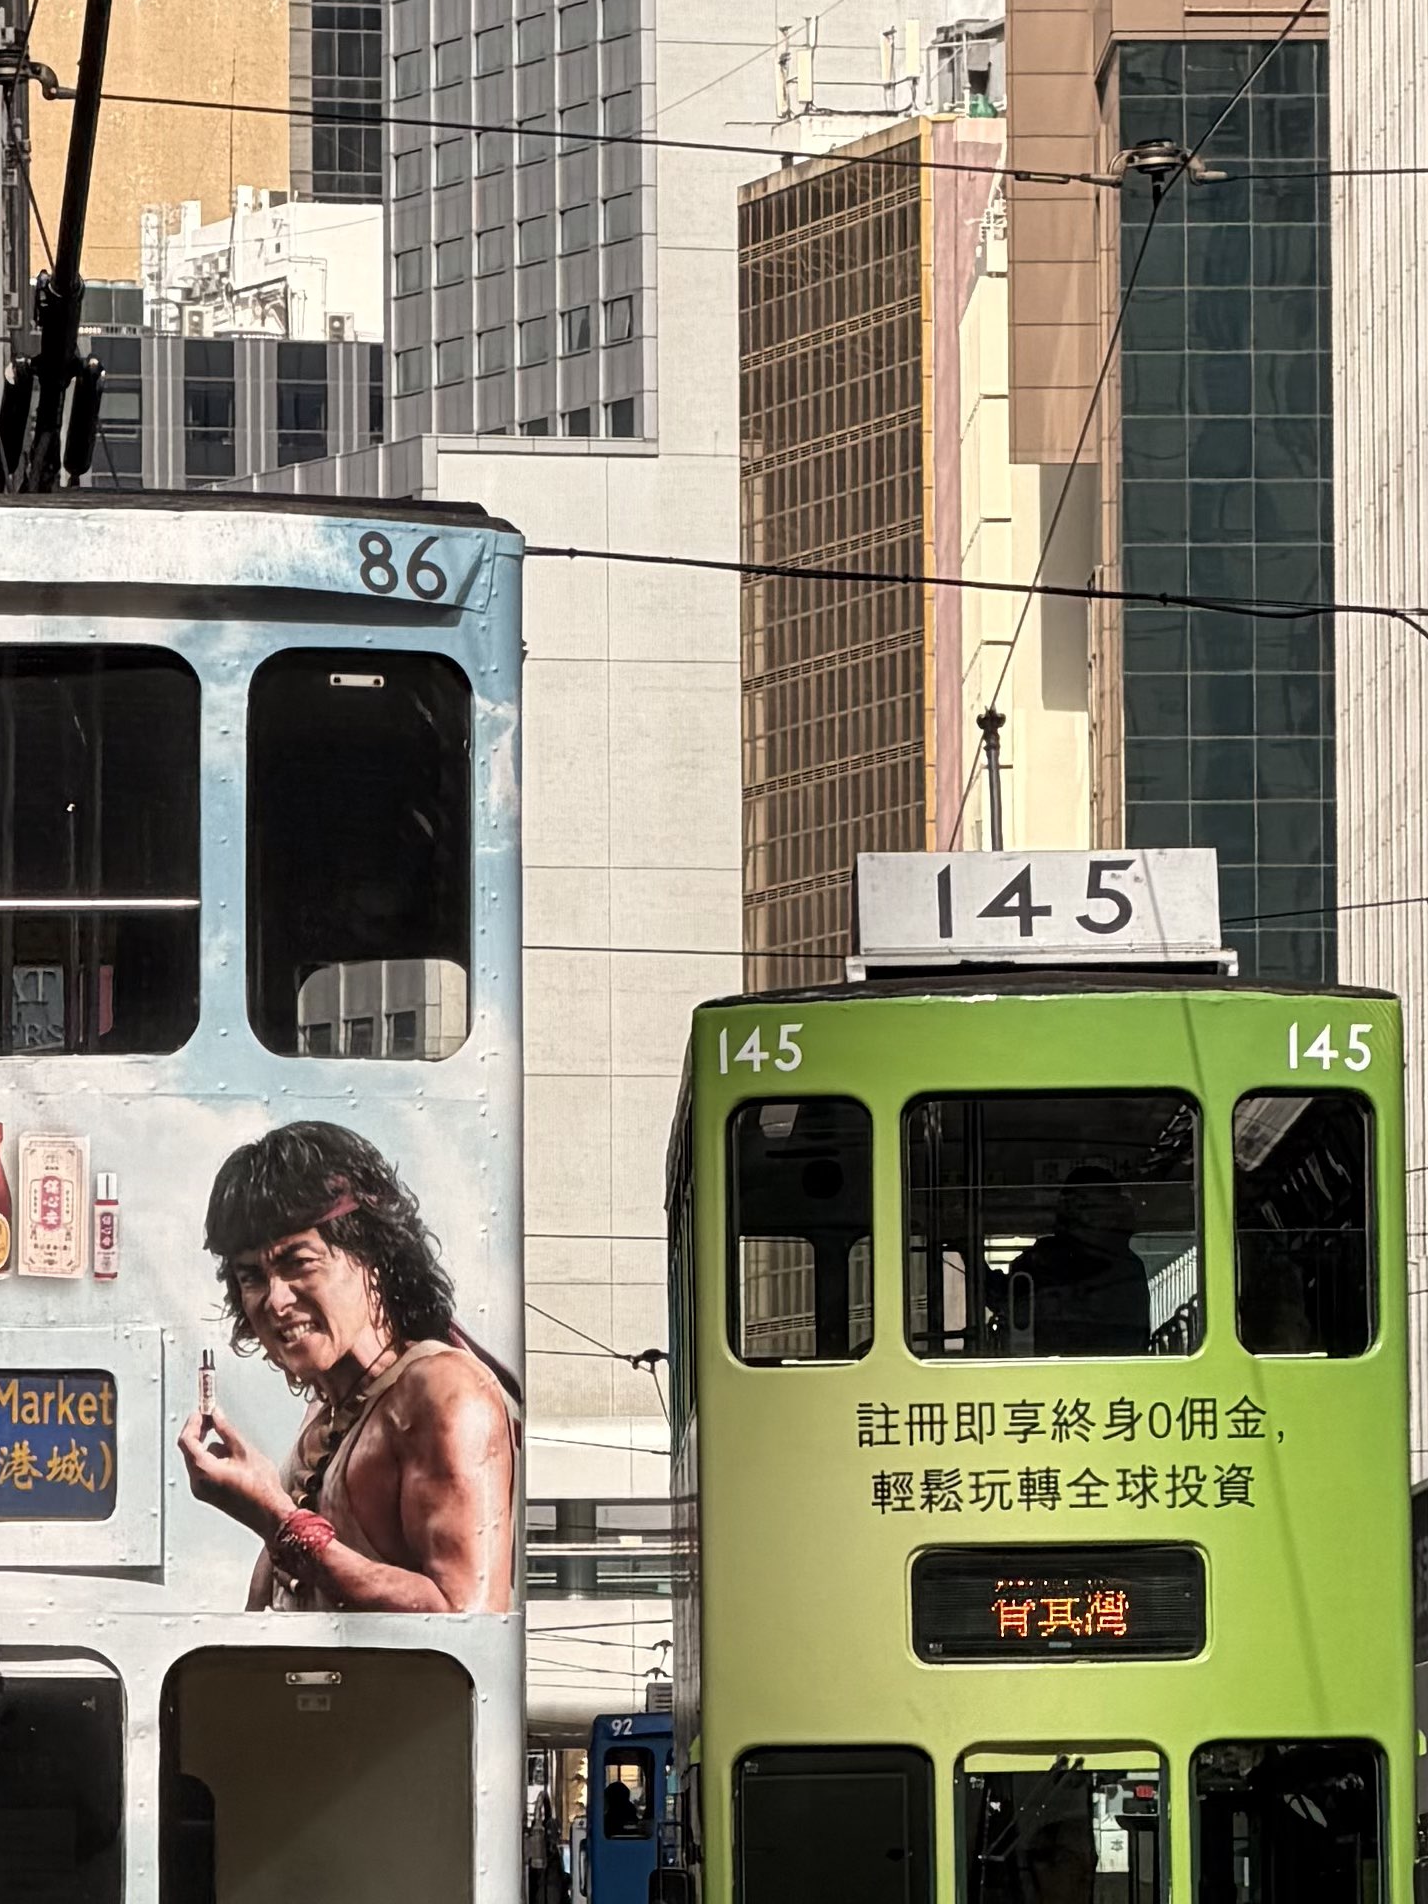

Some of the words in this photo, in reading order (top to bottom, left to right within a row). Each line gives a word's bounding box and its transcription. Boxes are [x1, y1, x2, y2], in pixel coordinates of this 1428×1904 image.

[359, 530, 447, 601] 86
[937, 860, 1134, 938] 145
[719, 1023, 803, 1073] 145
[1288, 1023, 1373, 1073] 145
[871, 1464, 1257, 1513] 輕鬆玩轉全球投資
[610, 1718, 634, 1737] 92
